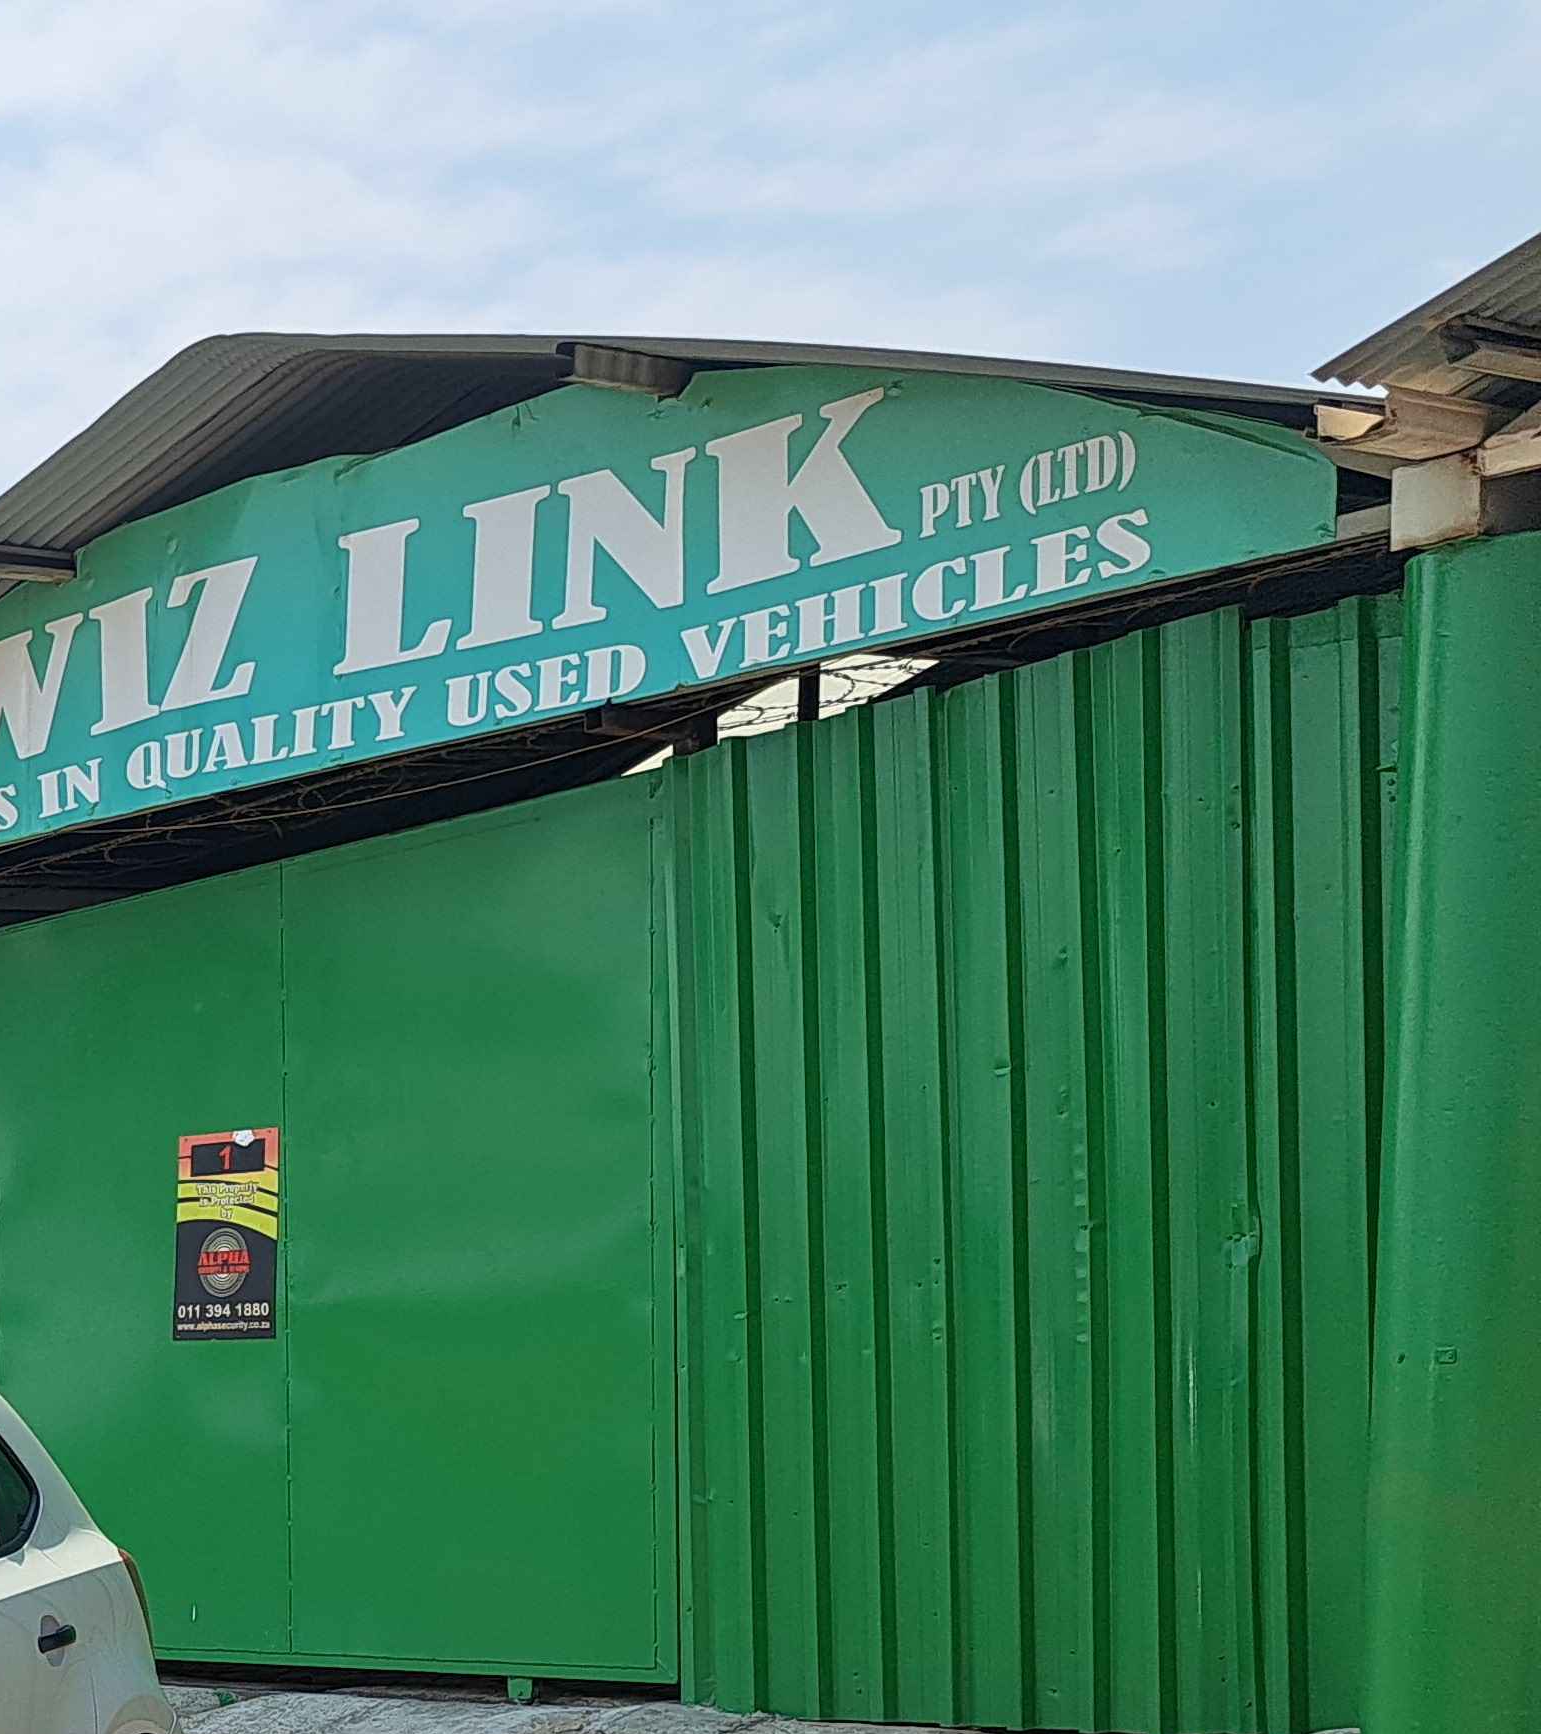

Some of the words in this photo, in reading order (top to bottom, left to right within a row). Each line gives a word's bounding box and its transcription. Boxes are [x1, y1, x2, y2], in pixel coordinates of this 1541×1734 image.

[333, 387, 903, 678] LINK
[919, 450, 1005, 541] PTY
[1018, 430, 1139, 516] (LTD)
[39, 760, 103, 823] IN
[127, 684, 418, 798] QUALITY
[445, 643, 648, 729] USED
[680, 507, 1152, 684] VEHICLES
[219, 1146, 231, 1169] 1
[199, 1251, 250, 1266] ALPHA
[178, 1304, 200, 1318] 011
[206, 1304, 230, 1317] 394
[235, 1302, 269, 1317] 1880
[177, 1321, 270, 1333] www.alphasecurity.co.za
